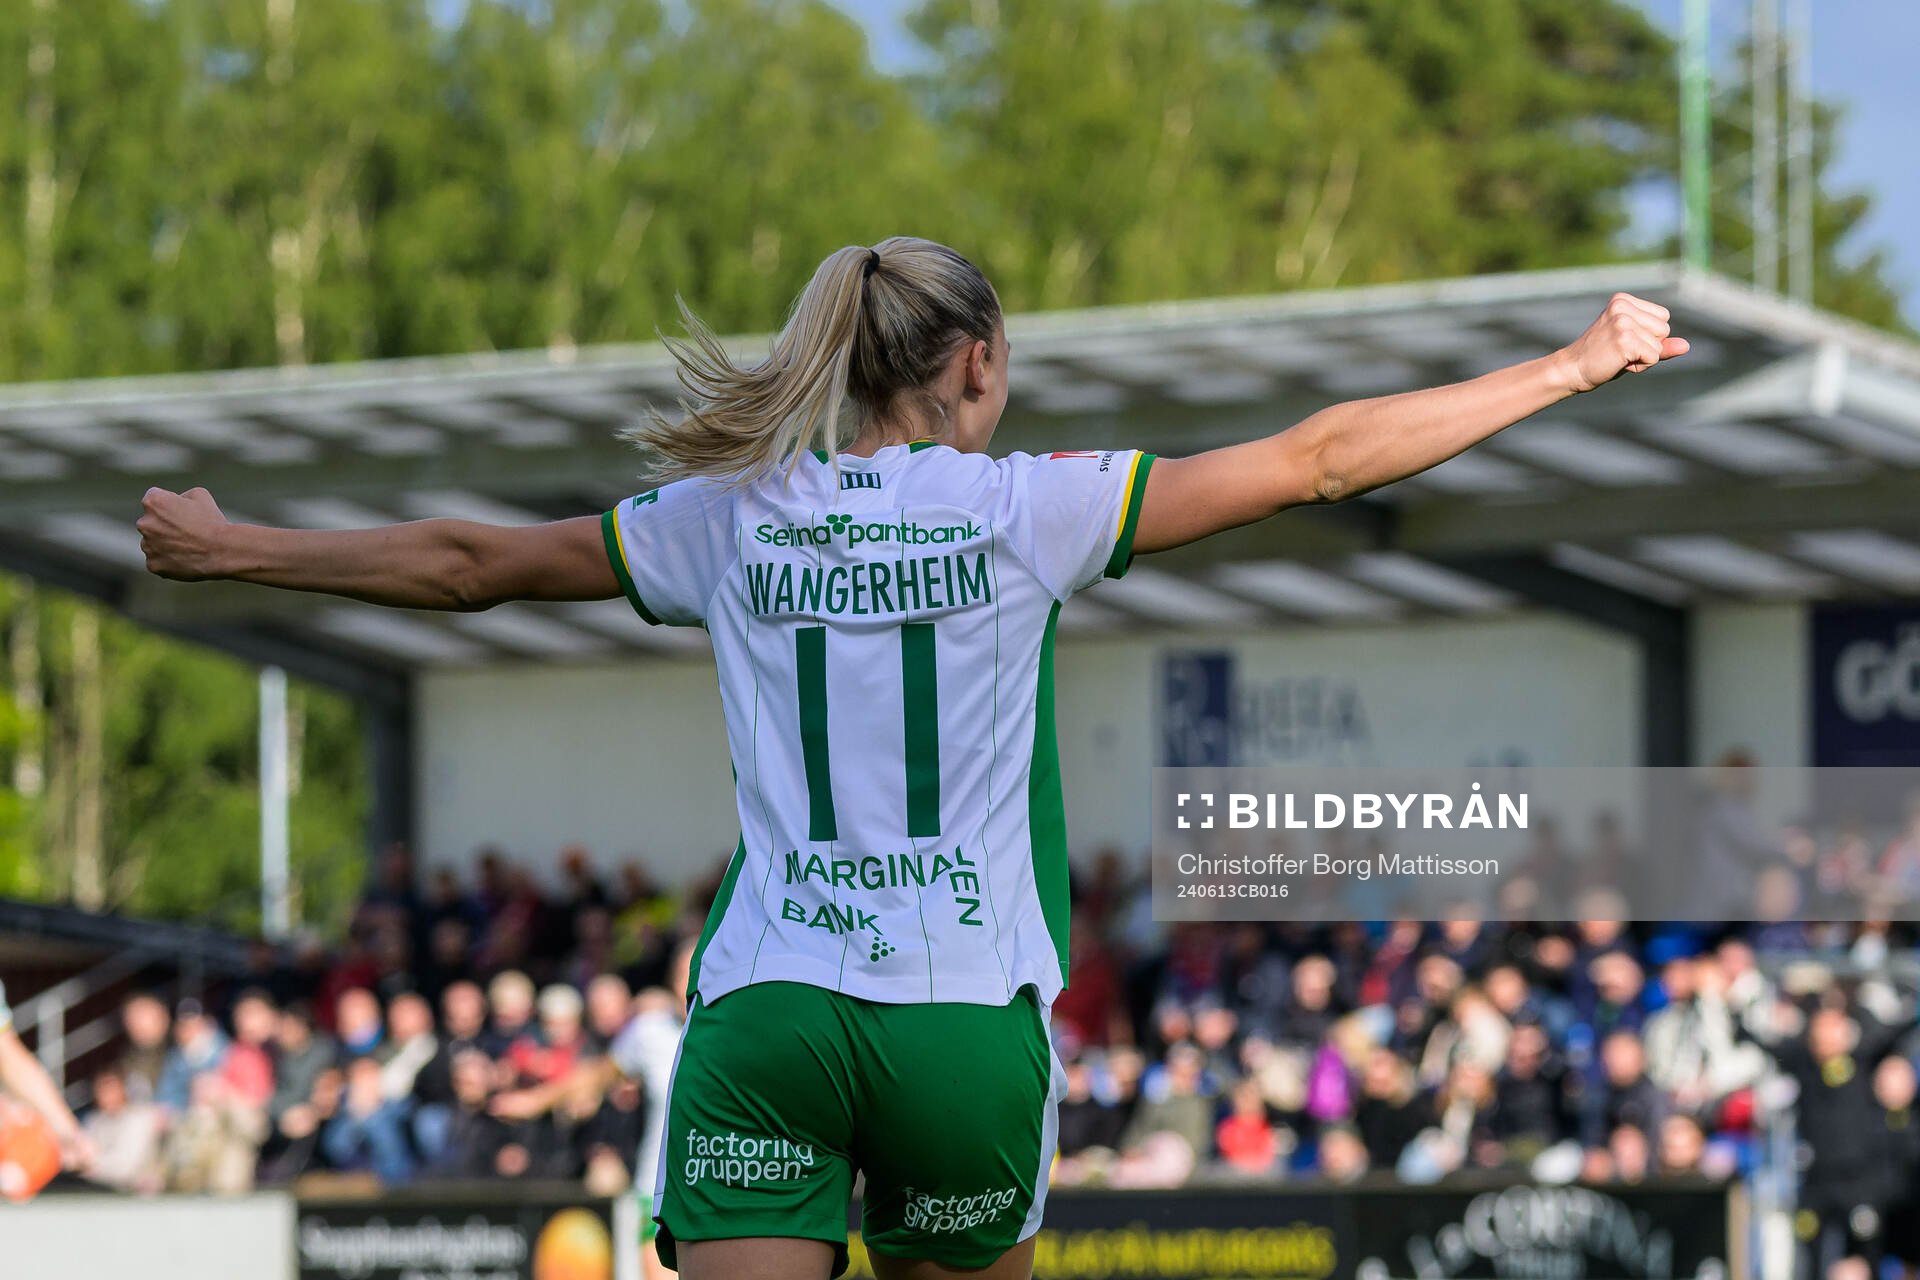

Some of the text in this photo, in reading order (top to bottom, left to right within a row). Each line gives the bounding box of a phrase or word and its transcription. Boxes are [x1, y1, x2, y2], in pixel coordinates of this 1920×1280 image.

[848, 520, 982, 549] pantbank
[746, 552, 991, 615] WANGERHEIM
[795, 622, 942, 842] 11
[781, 897, 884, 936] BANK
[687, 1128, 814, 1167] factoring
[903, 1186, 1018, 1216] factoring
